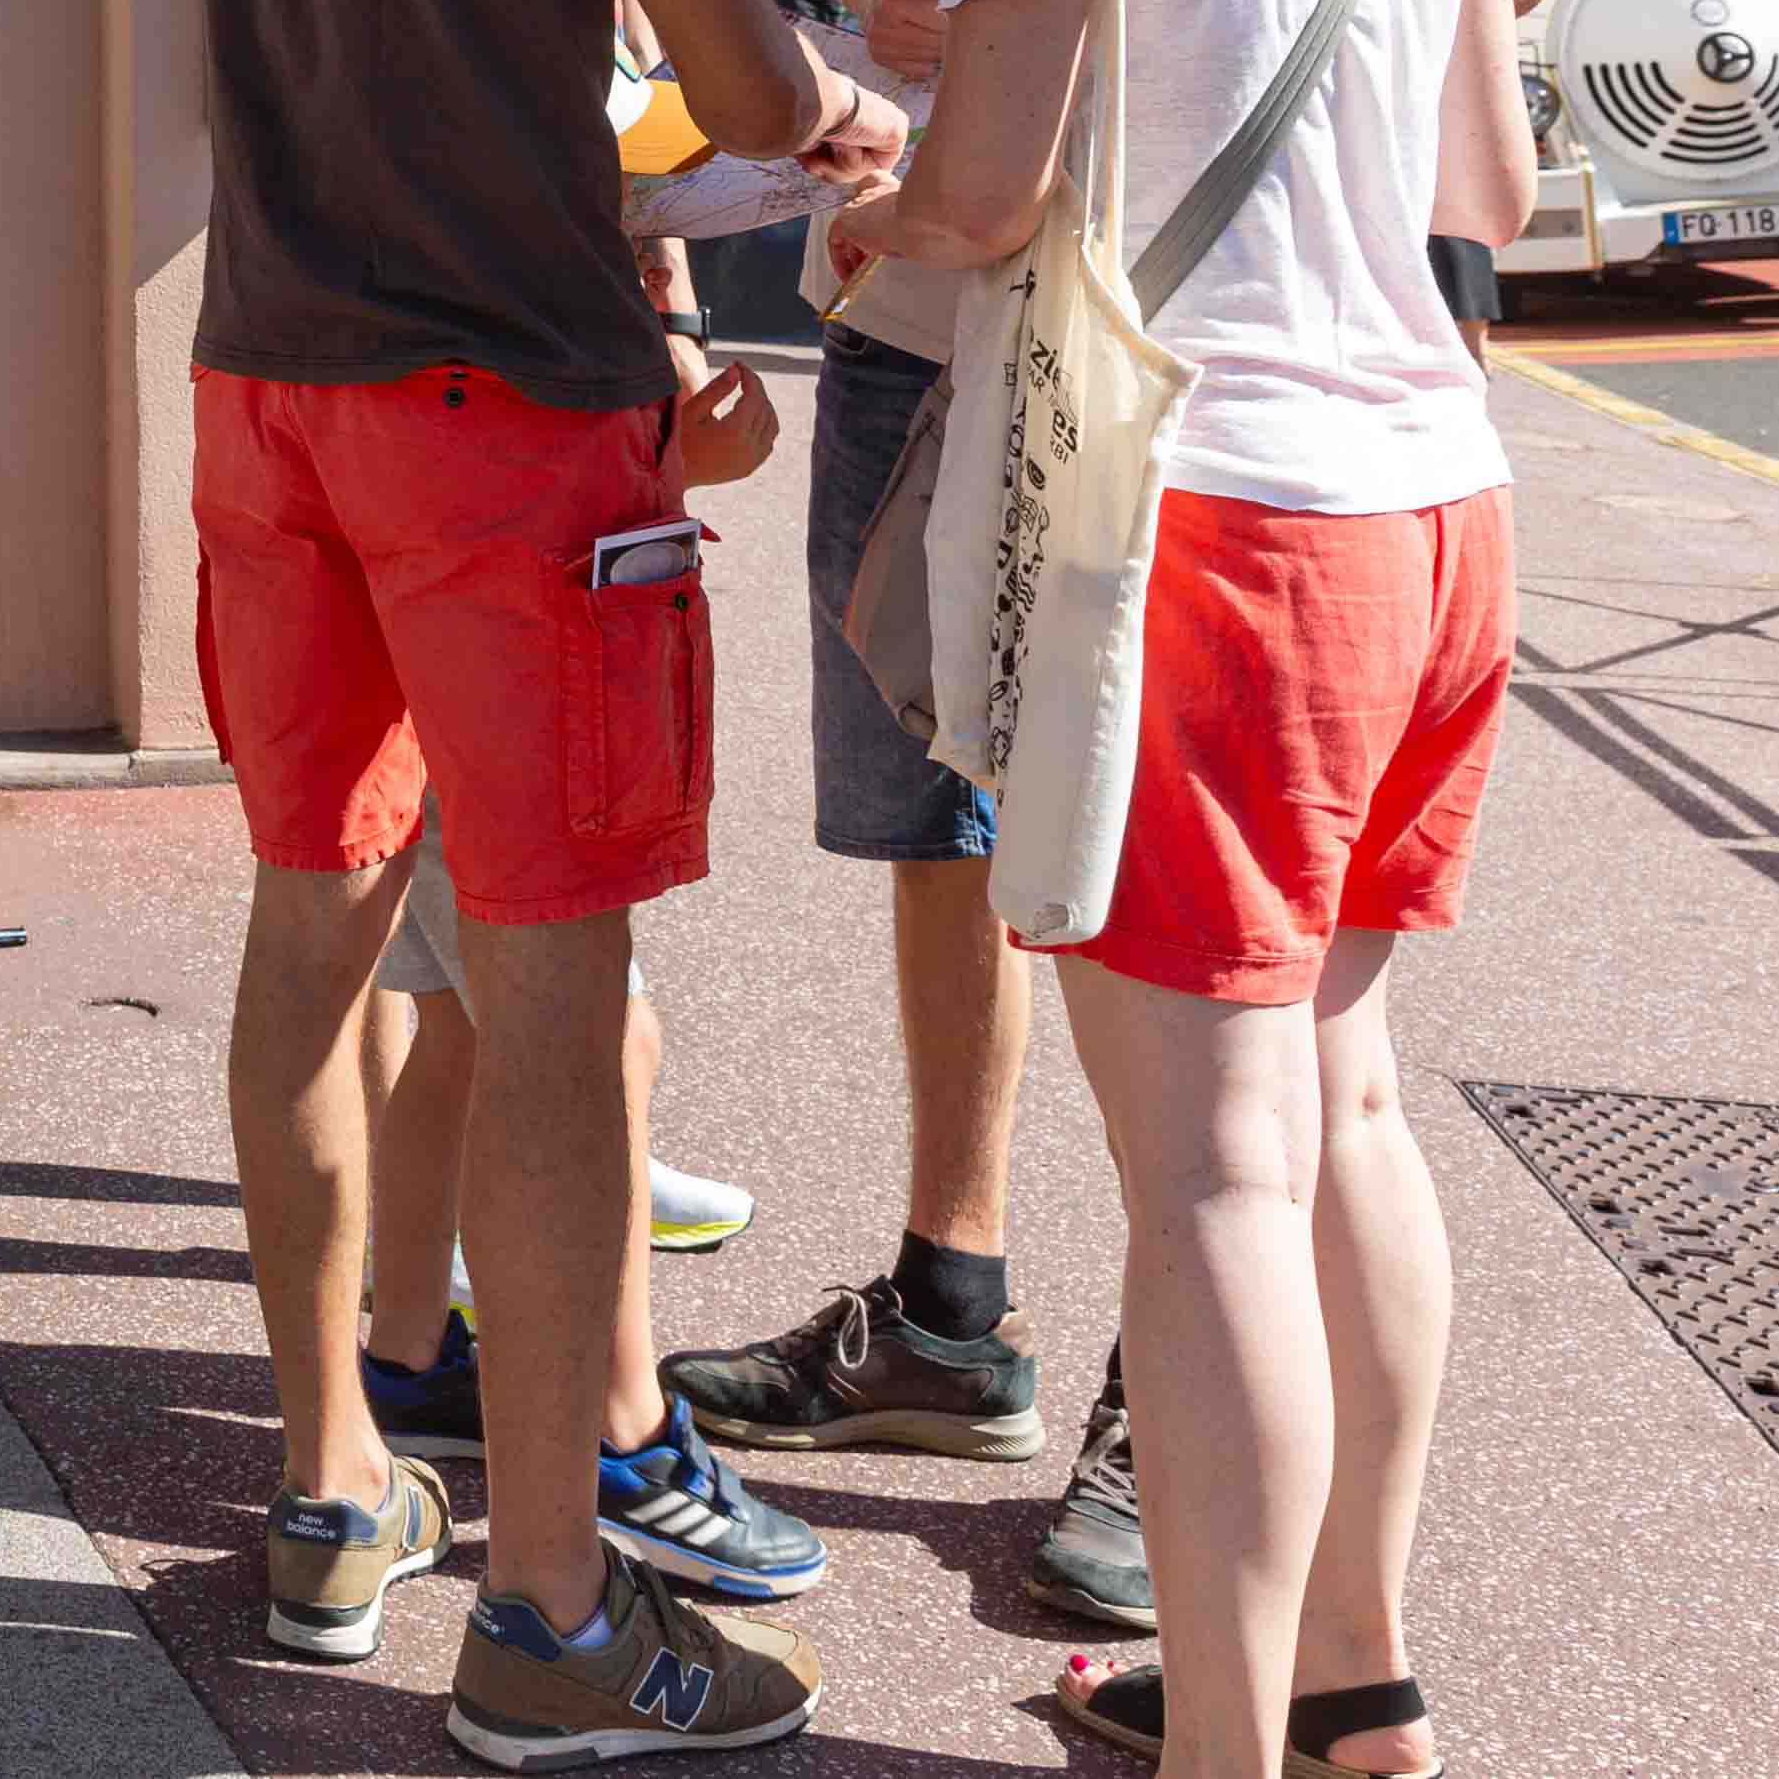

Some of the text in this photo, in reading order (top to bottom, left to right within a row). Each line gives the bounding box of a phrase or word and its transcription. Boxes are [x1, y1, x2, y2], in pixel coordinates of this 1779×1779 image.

[285, 1520, 338, 1541] balance
[297, 1512, 325, 1528] new
[629, 1645, 715, 1731] N
